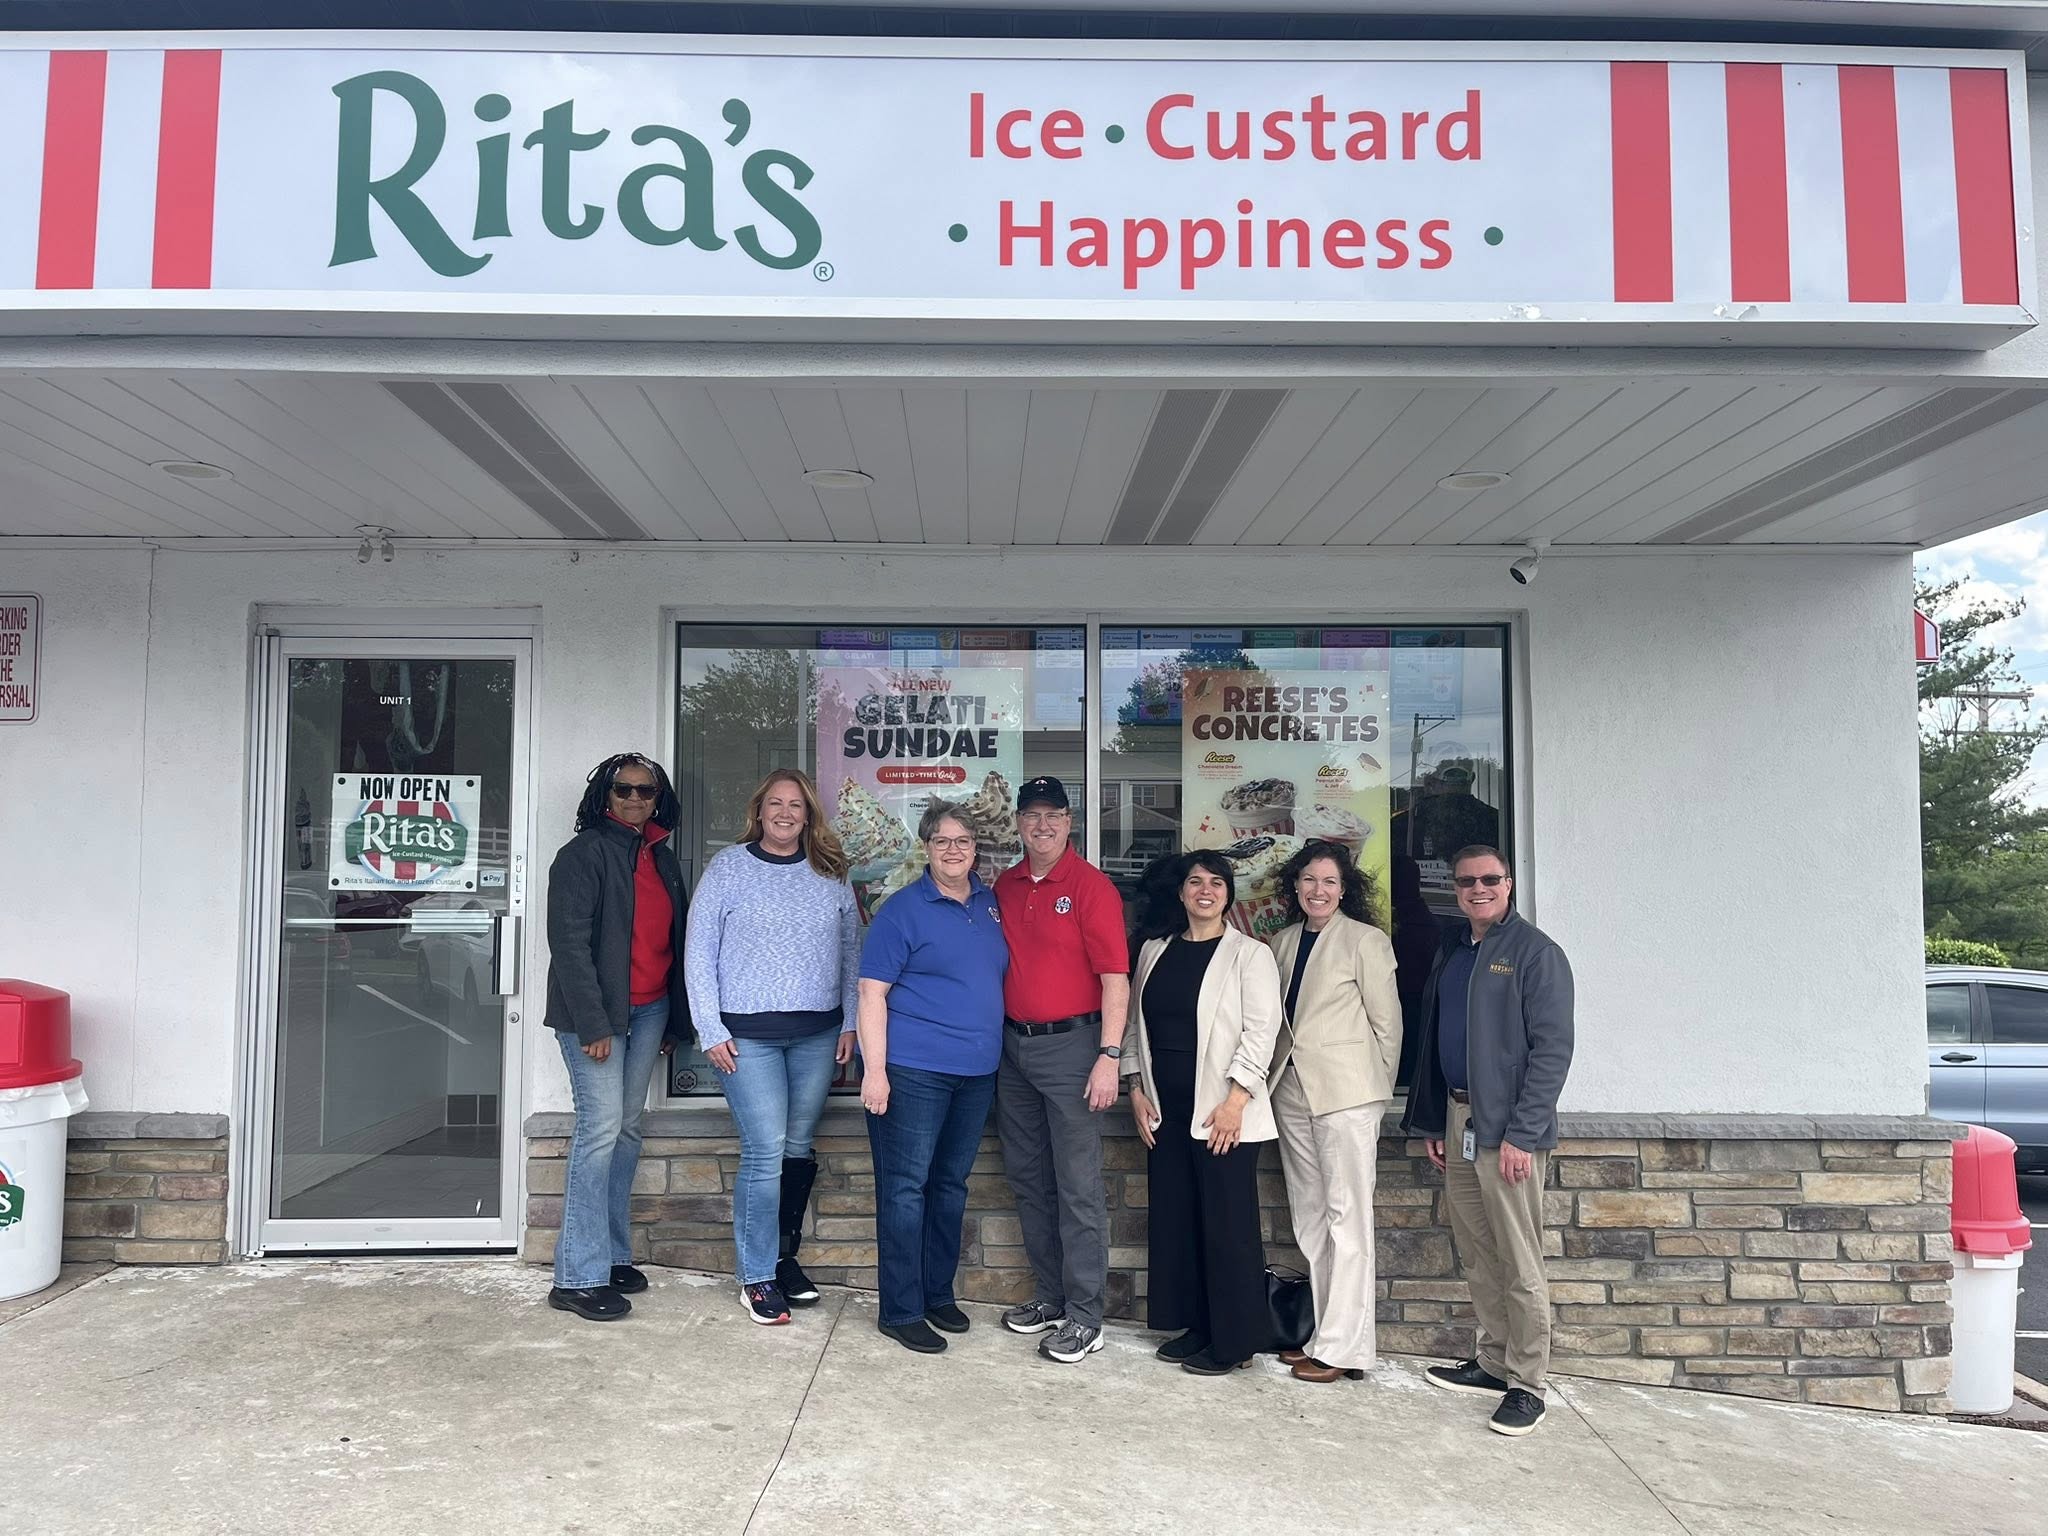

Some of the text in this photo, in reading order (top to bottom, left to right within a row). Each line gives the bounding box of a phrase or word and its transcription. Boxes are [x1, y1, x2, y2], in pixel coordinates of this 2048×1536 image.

[969, 89, 1483, 161] Ice Custard
[328, 70, 823, 277] Rita's
[998, 198, 1453, 290] Happiness
[0, 633, 21, 656] DER
[0, 659, 13, 682] HE
[919, 680, 952, 691] NEW
[1223, 686, 1349, 713] REESE'S
[379, 696, 412, 705] UNIT 1
[855, 695, 987, 726] GELATI
[1191, 714, 1380, 742] CONCRETES
[843, 726, 999, 759] SUNDAE
[360, 777, 451, 802] NOW OPEN
[361, 812, 456, 854] Rita's
[488, 875, 501, 883] Pay
[515, 855, 523, 893] PULL
